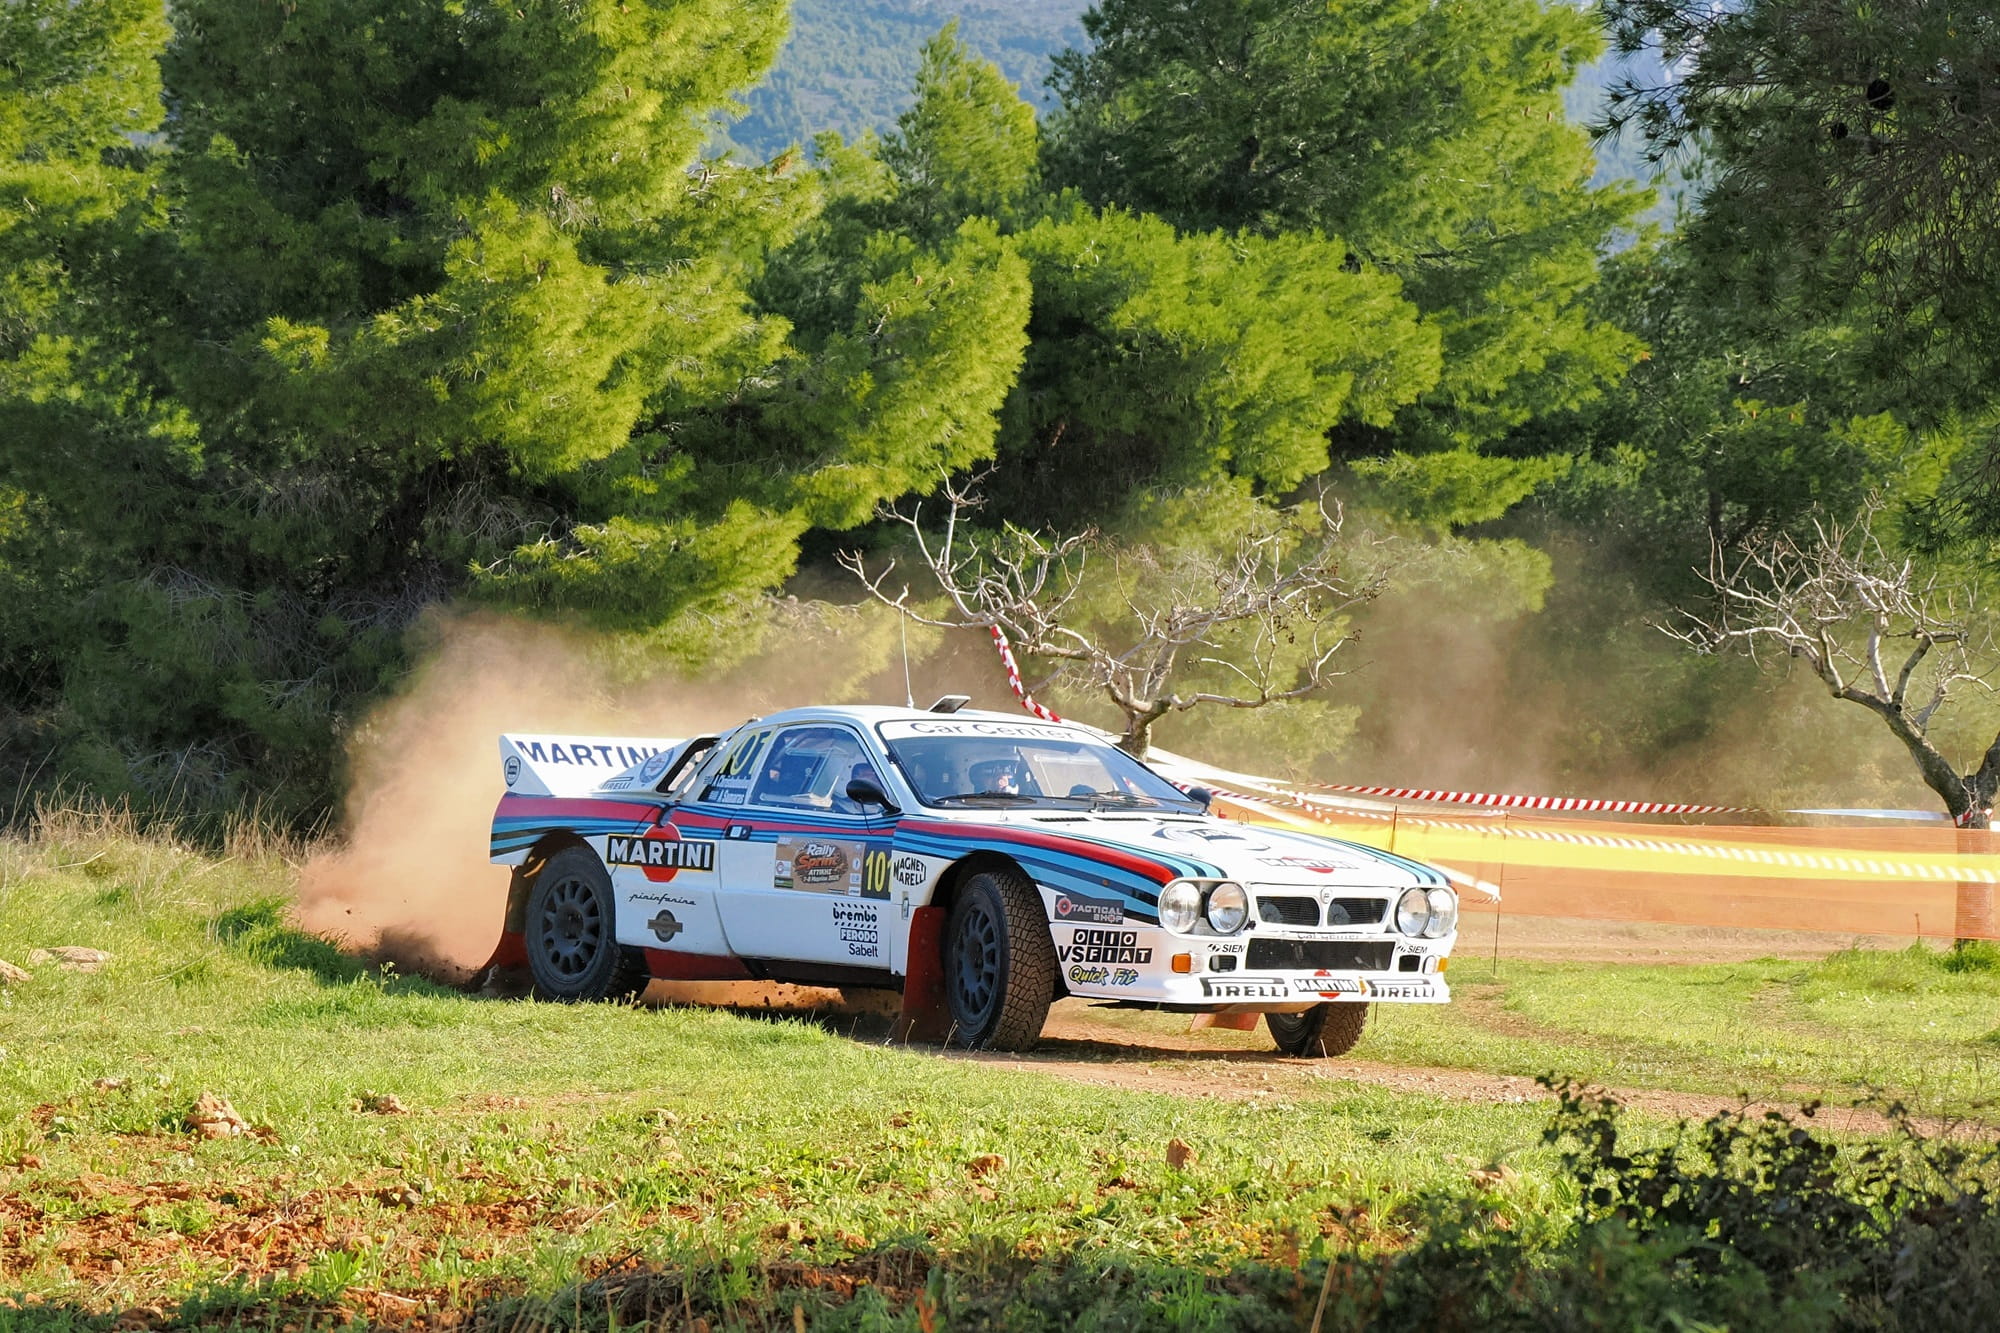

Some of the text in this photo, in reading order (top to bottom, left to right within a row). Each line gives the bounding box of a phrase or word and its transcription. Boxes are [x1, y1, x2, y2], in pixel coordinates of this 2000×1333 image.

[910, 722, 1073, 739] Car Center
[610, 838, 711, 868] MARTINI
[807, 844, 836, 858] Rally
[798, 856, 837, 870] Sprint
[894, 857, 926, 874] MAGNETI
[629, 892, 697, 905] pininfarina
[833, 907, 877, 923] brembo
[1071, 903, 1123, 915] TACTICAL
[841, 928, 877, 943] FERODO
[1075, 931, 1135, 946] OLIO
[849, 943, 878, 957] Sabelt
[1069, 965, 1139, 986] Quick Fit
[1199, 977, 1289, 997] PIRELLI
[1293, 979, 1359, 993] MARTINI
[1366, 979, 1435, 998] PIRELLI
